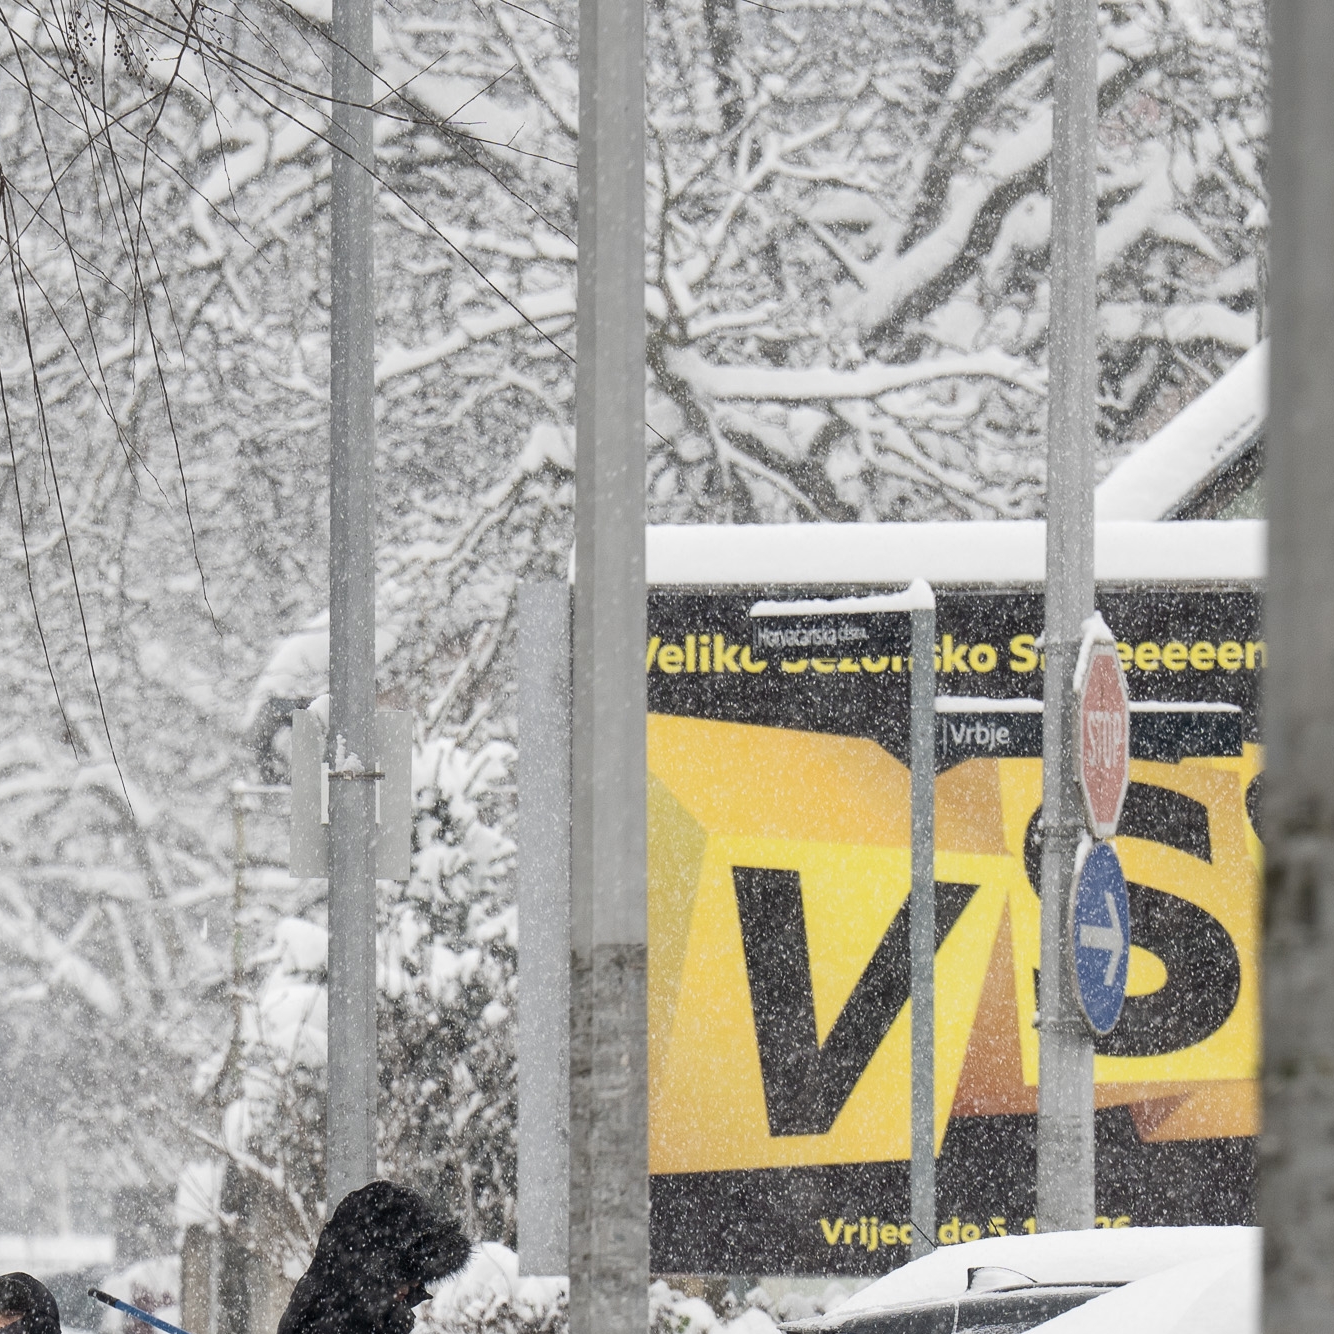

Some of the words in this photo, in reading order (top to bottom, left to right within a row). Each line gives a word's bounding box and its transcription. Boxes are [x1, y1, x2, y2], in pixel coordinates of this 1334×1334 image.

[950, 722, 1010, 750] Vrbje
[1088, 711, 1122, 769] STOP
[938, 1217, 981, 1245] do
